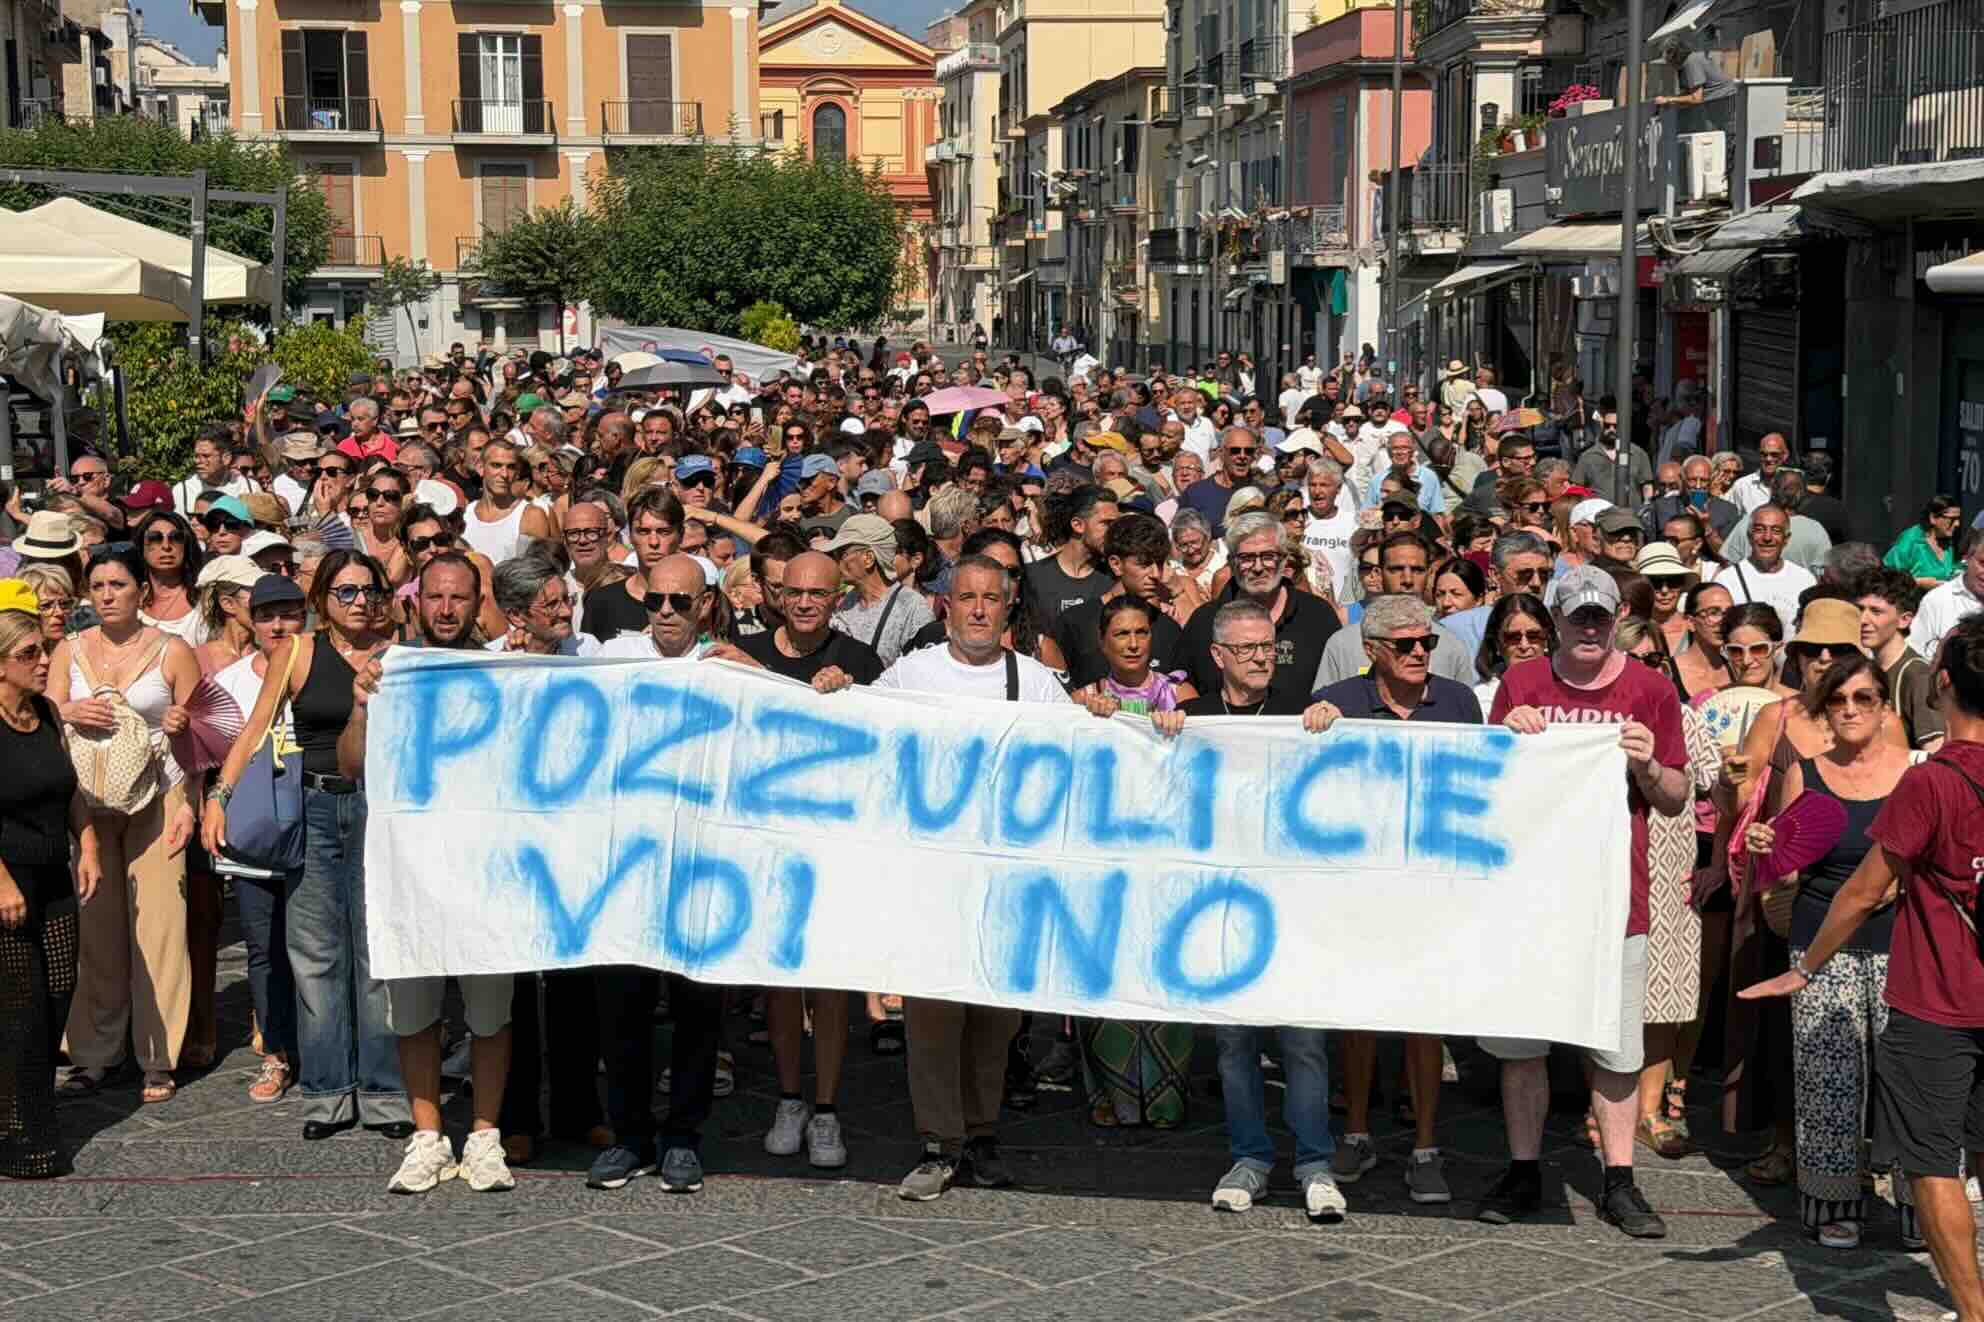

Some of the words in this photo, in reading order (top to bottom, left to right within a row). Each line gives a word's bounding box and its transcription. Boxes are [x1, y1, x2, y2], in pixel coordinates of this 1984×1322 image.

[1304, 536, 1347, 549] rangle
[399, 667, 1221, 853] POZZUOLI
[518, 836, 817, 971] VOI
[1007, 868, 1279, 1000] NO
